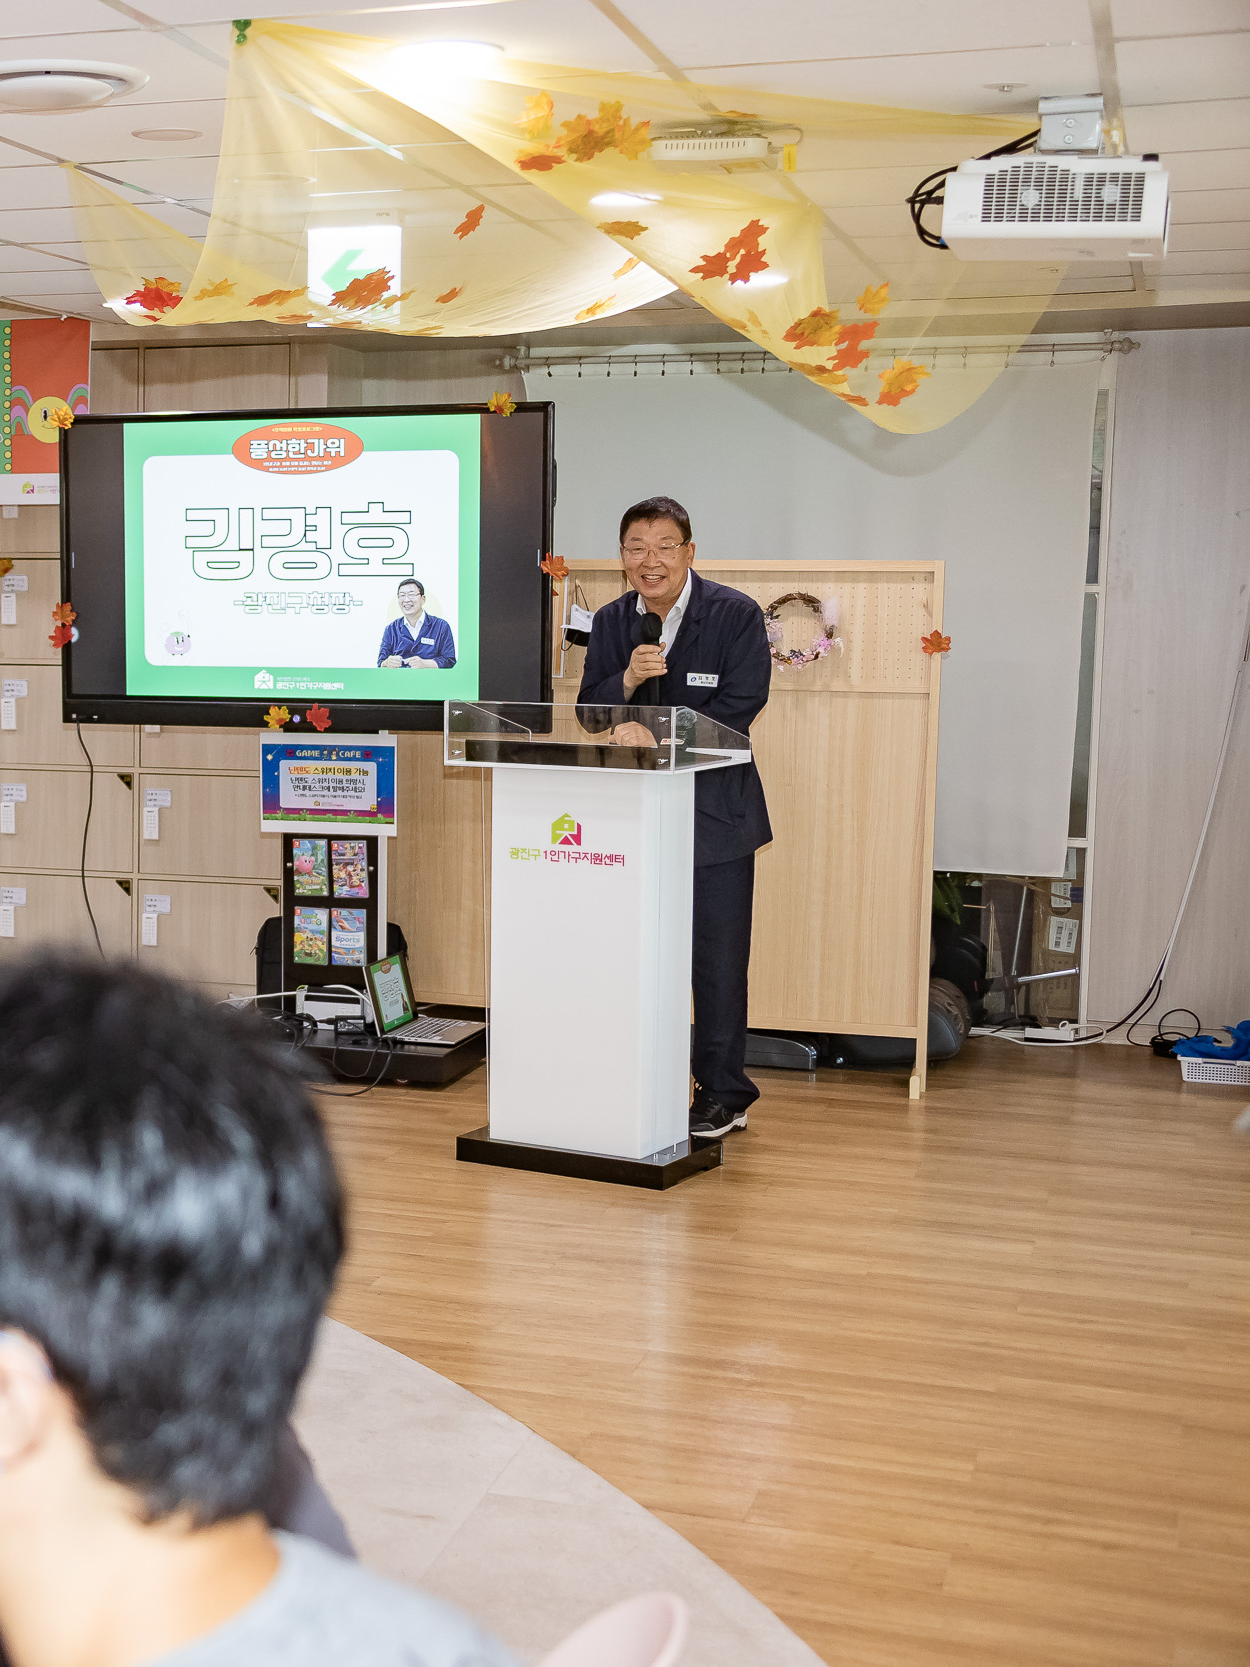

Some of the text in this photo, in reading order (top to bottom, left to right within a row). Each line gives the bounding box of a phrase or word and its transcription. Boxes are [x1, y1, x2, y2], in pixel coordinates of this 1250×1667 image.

[249, 438, 345, 460] 풍성한가위
[185, 501, 414, 581] 김경호
[295, 749, 362, 758] GAME CAFE
[288, 766, 370, 776] 닌텐도 스위치 이용 가능
[310, 777, 330, 785] 스위치
[330, 777, 344, 785] 이용
[292, 784, 331, 792] 안내데스크에
[509, 847, 625, 867] 광진구 1인가구지원센터
[335, 935, 360, 944] Sports
